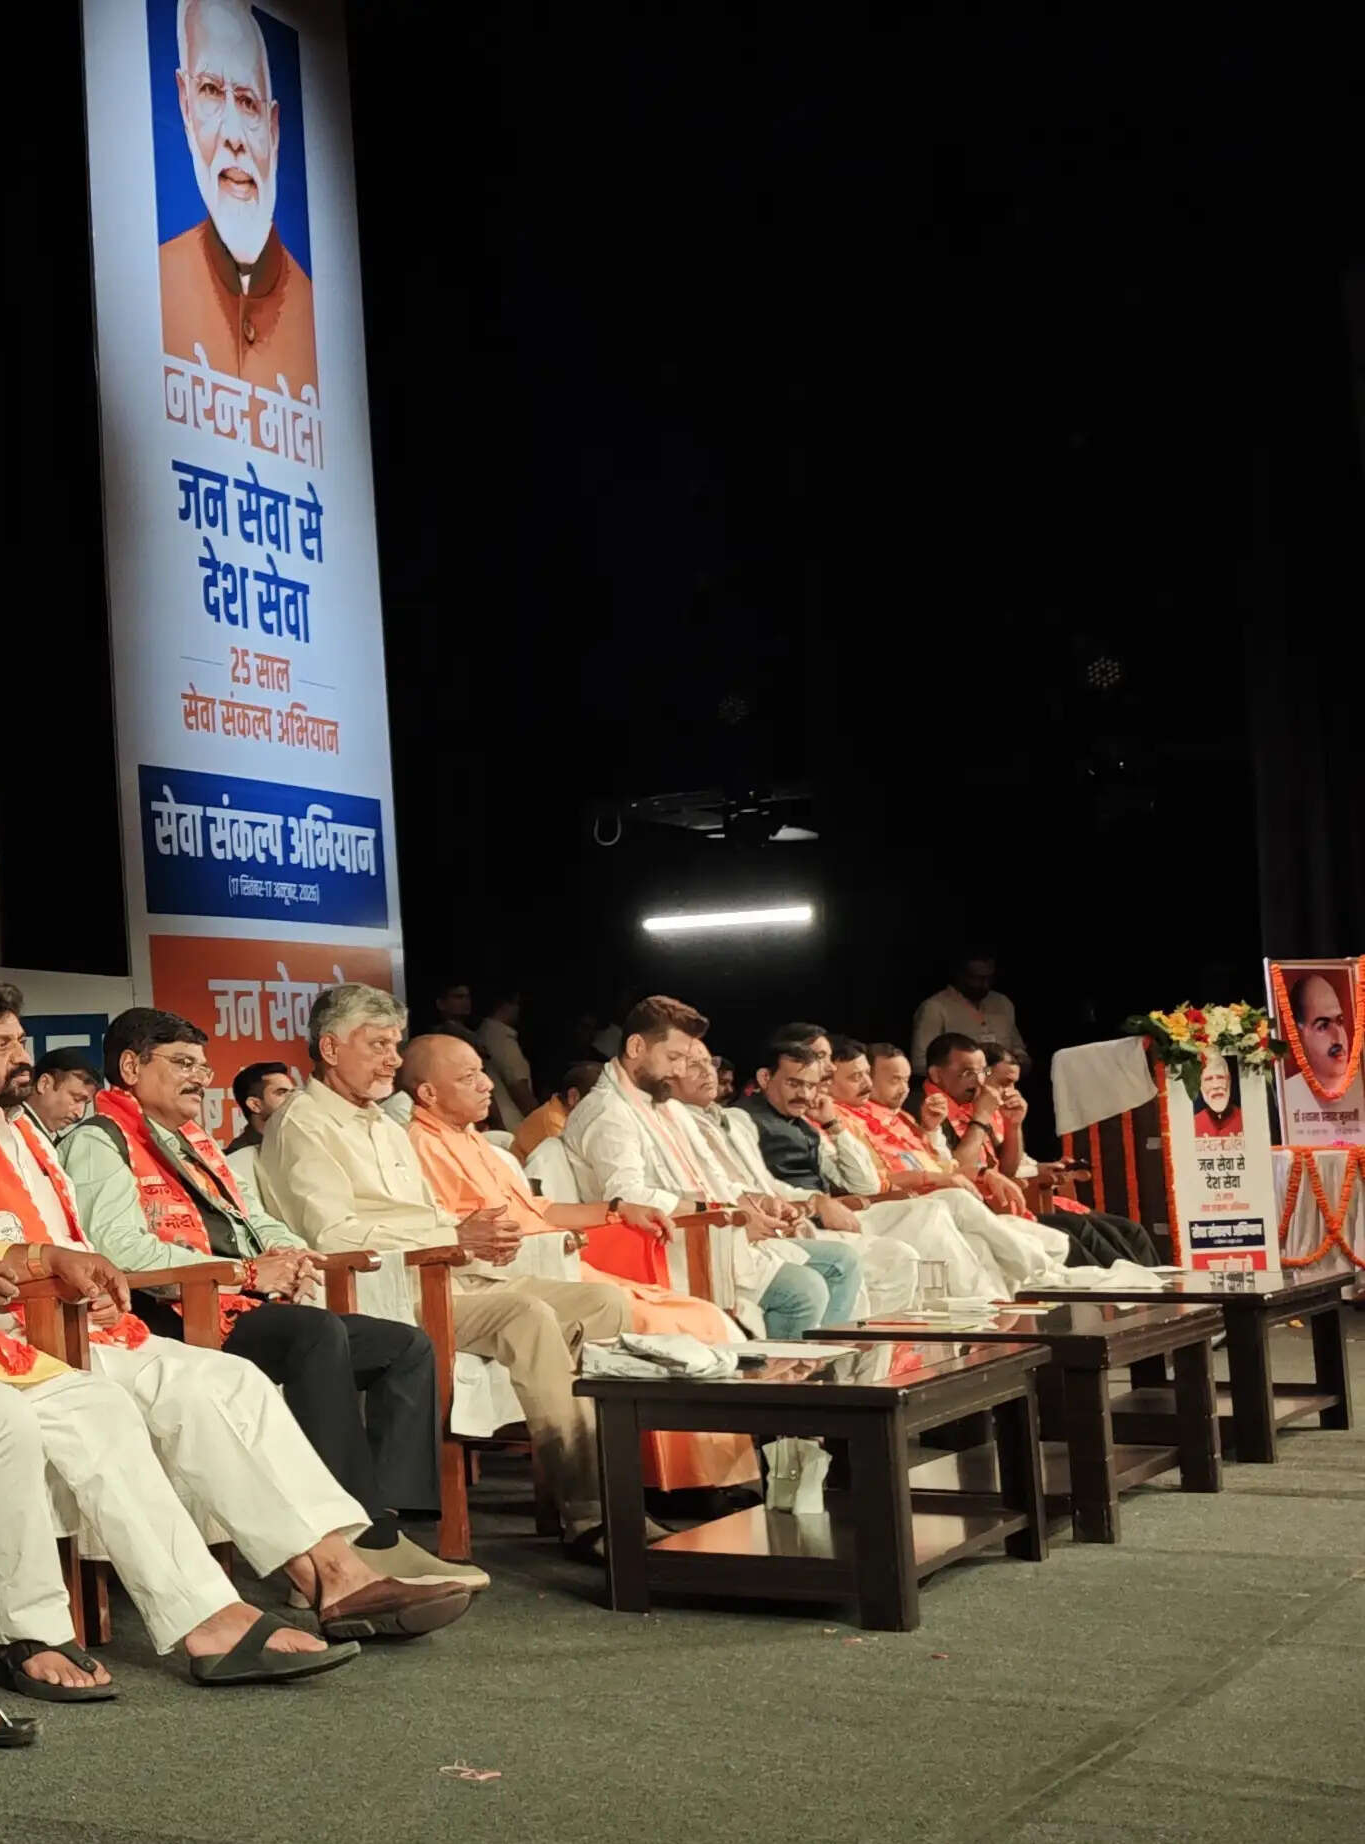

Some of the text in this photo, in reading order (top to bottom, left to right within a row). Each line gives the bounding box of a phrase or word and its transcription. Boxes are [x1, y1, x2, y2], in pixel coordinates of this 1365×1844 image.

[255, 373, 324, 469] मोदी
[172, 459, 323, 564] जन सेवा से
[198, 536, 310, 643] देश सेवा
[230, 646, 291, 693] 25 साल
[181, 682, 340, 755] सेवा संकल्प अभियान
[151, 784, 377, 876] सेवा संकल्प अभियान
[208, 961, 319, 1041] जन सेव
